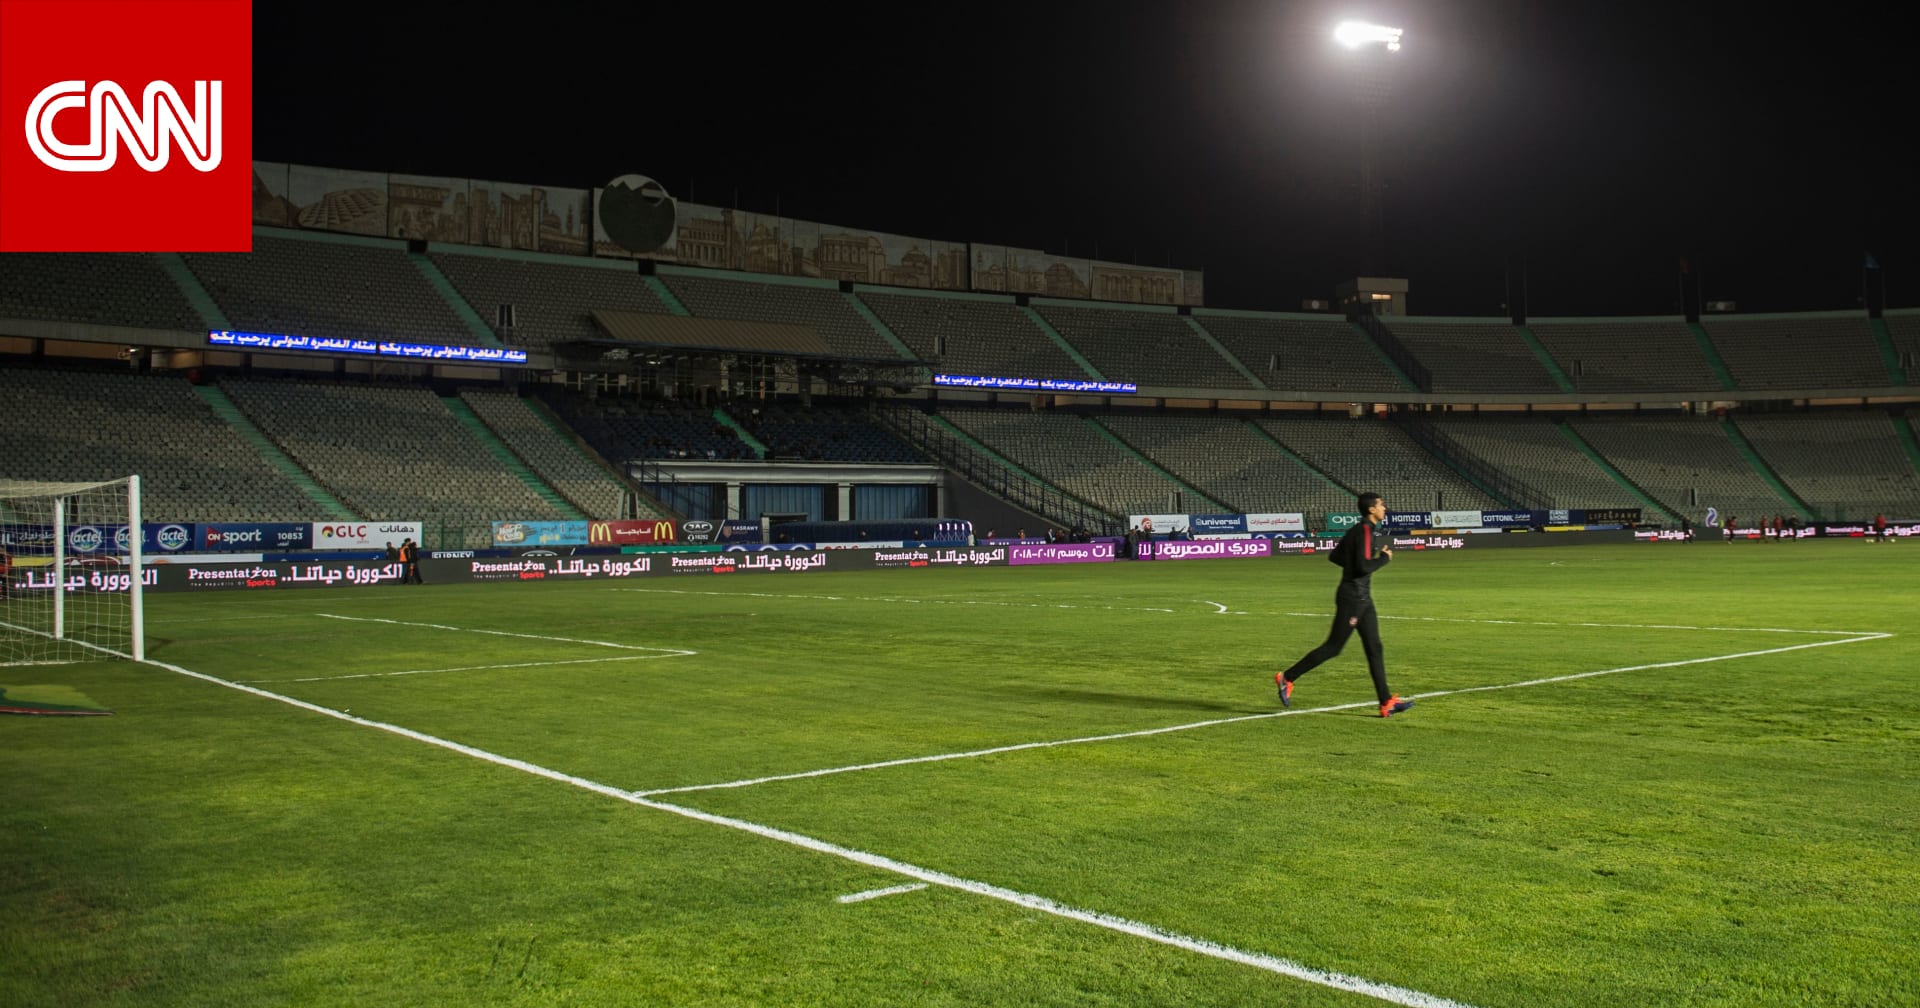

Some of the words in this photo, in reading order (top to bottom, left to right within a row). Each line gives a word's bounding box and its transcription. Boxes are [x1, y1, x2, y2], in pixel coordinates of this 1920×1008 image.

[1201, 517, 1241, 526] universal
[336, 525, 367, 538] GLC
[380, 525, 415, 533] دهانات
[207, 533, 220, 541] ON
[223, 529, 262, 543] sport
[1058, 550, 1088, 559] موسم
[1164, 542, 1224, 558] المصرية
[1228, 543, 1267, 555] دوري
[672, 555, 735, 567] Presentation
[784, 553, 826, 571] الكوورة
[969, 549, 1005, 564] الكوورة
[472, 560, 545, 572] Presentation
[603, 558, 650, 576] الكوورة
[189, 567, 277, 579] Presentation
[346, 563, 403, 584] الكوورة
[520, 571, 544, 579] Sports
[246, 579, 276, 588] Sports
